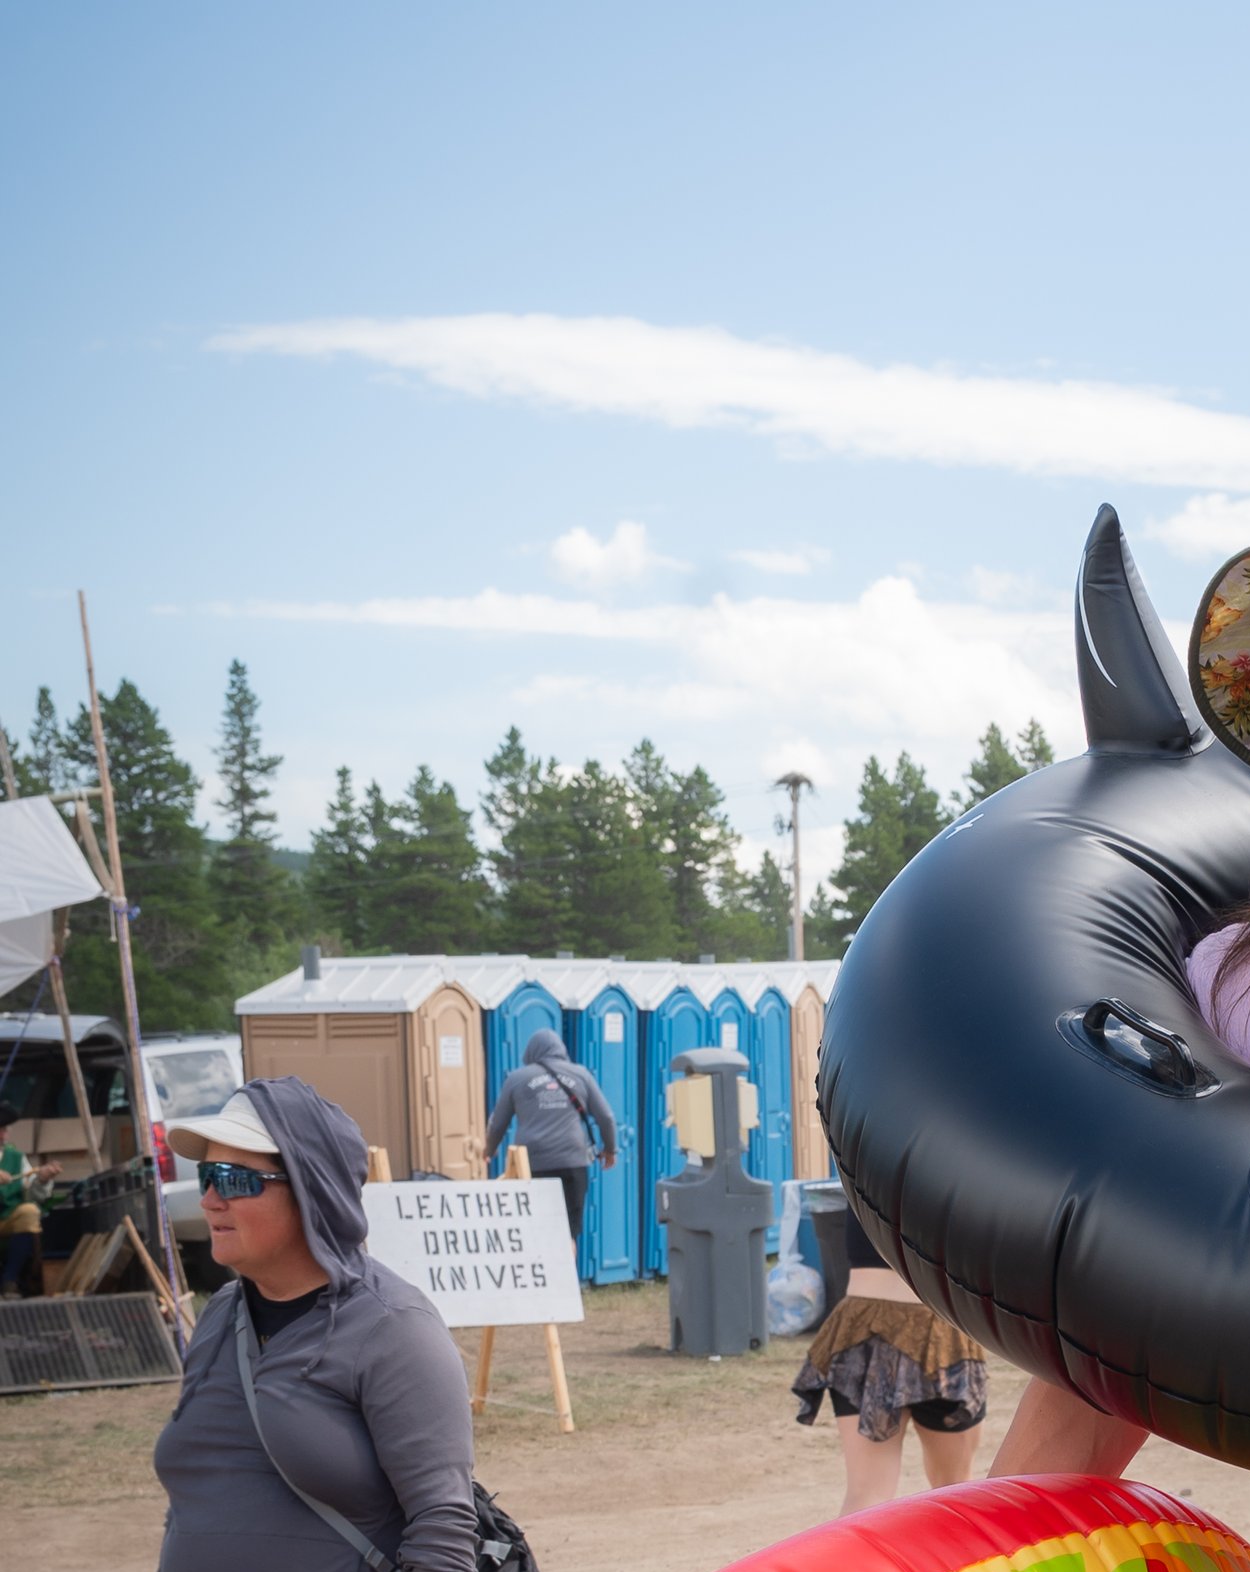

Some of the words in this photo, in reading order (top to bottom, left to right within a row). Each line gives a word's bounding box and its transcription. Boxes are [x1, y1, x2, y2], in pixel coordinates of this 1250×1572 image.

[396, 1192, 532, 1219] LEATHER
[424, 1228, 523, 1255] DRUMS
[429, 1263, 547, 1291] KNIVES
